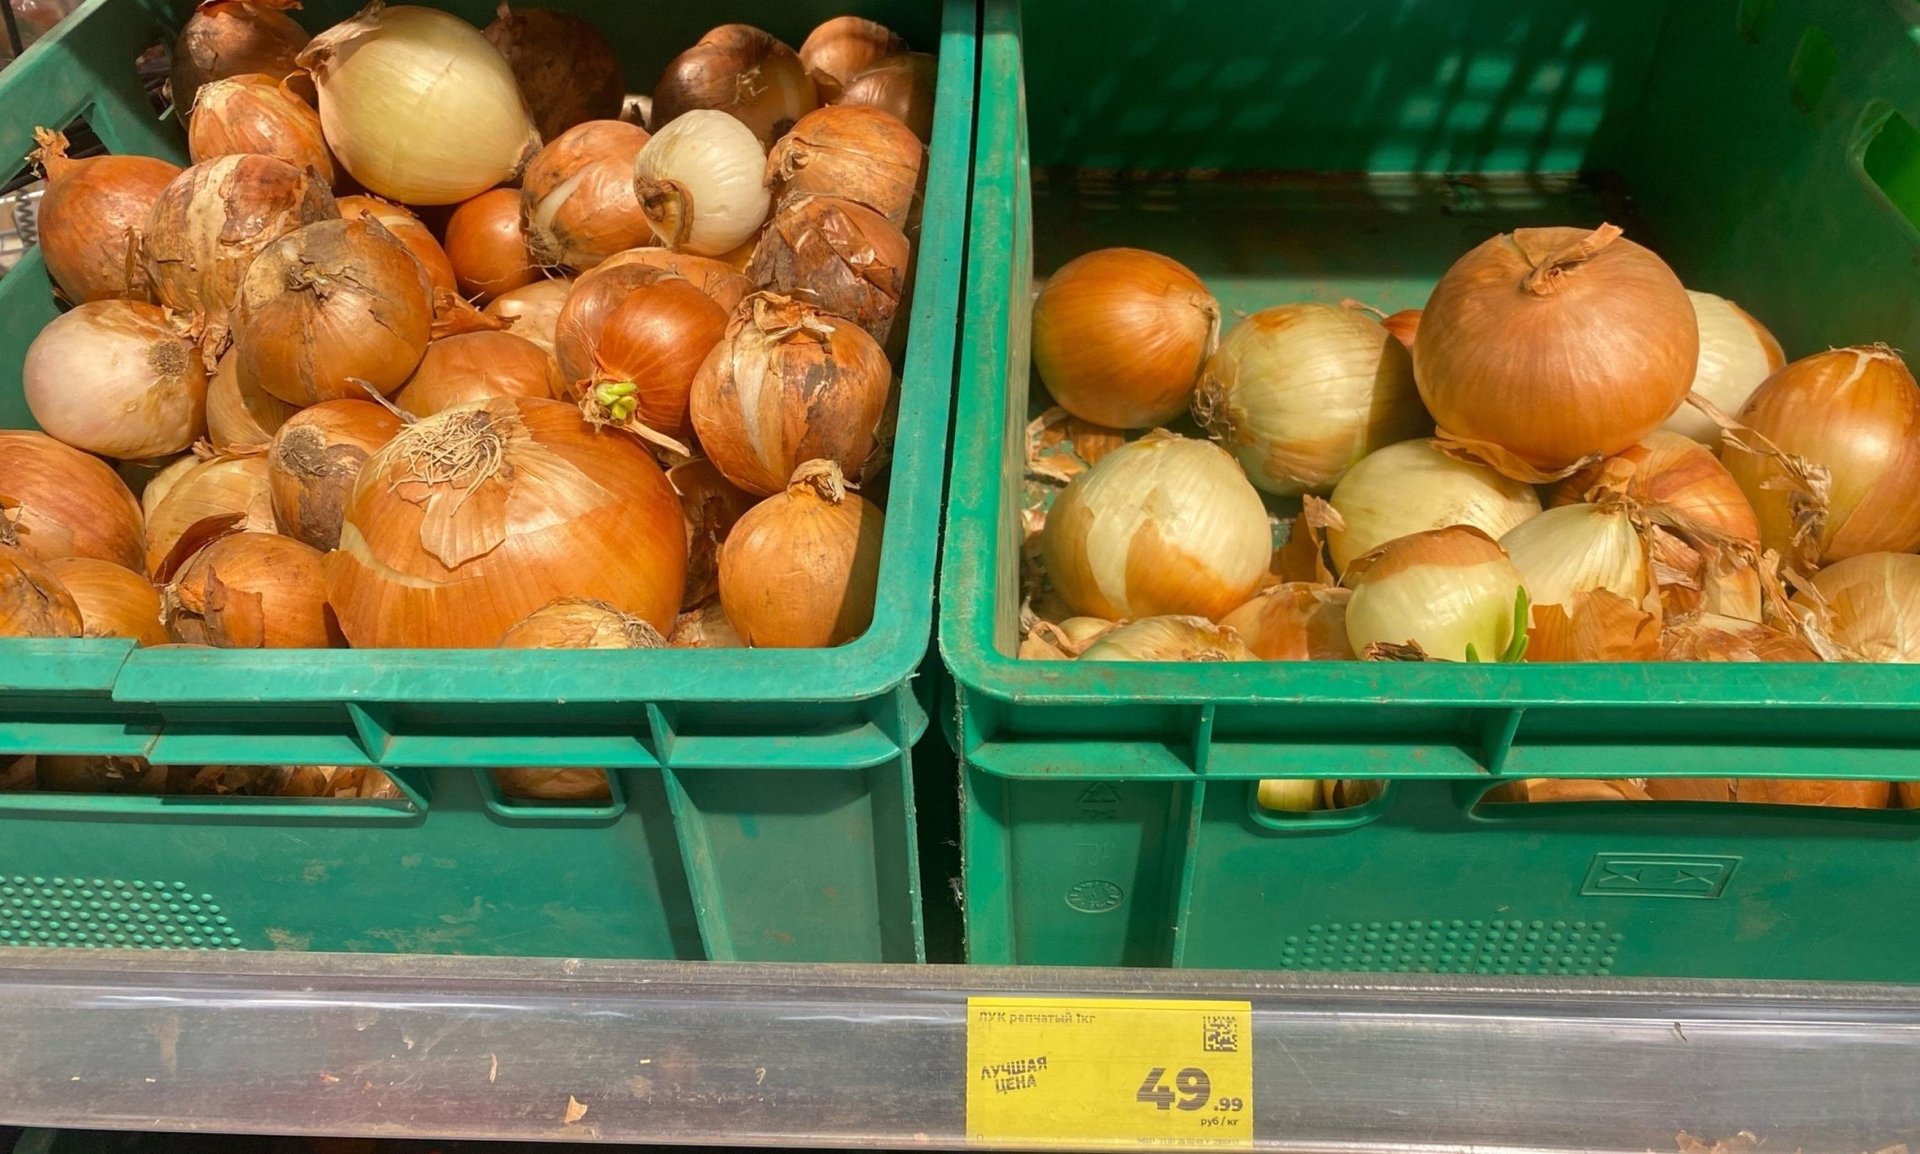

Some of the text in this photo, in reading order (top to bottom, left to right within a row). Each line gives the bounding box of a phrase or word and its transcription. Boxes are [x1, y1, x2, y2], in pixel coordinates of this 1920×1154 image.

[979, 1011, 1006, 1023] ЛУК
[1009, 1012, 1073, 1025] репчатый
[981, 1056, 1048, 1081] ЛУЧШАЯ
[995, 1074, 1037, 1095] ЦЕНА
[1200, 1117, 1219, 1127] руб
[1227, 1118, 1239, 1126] кг
